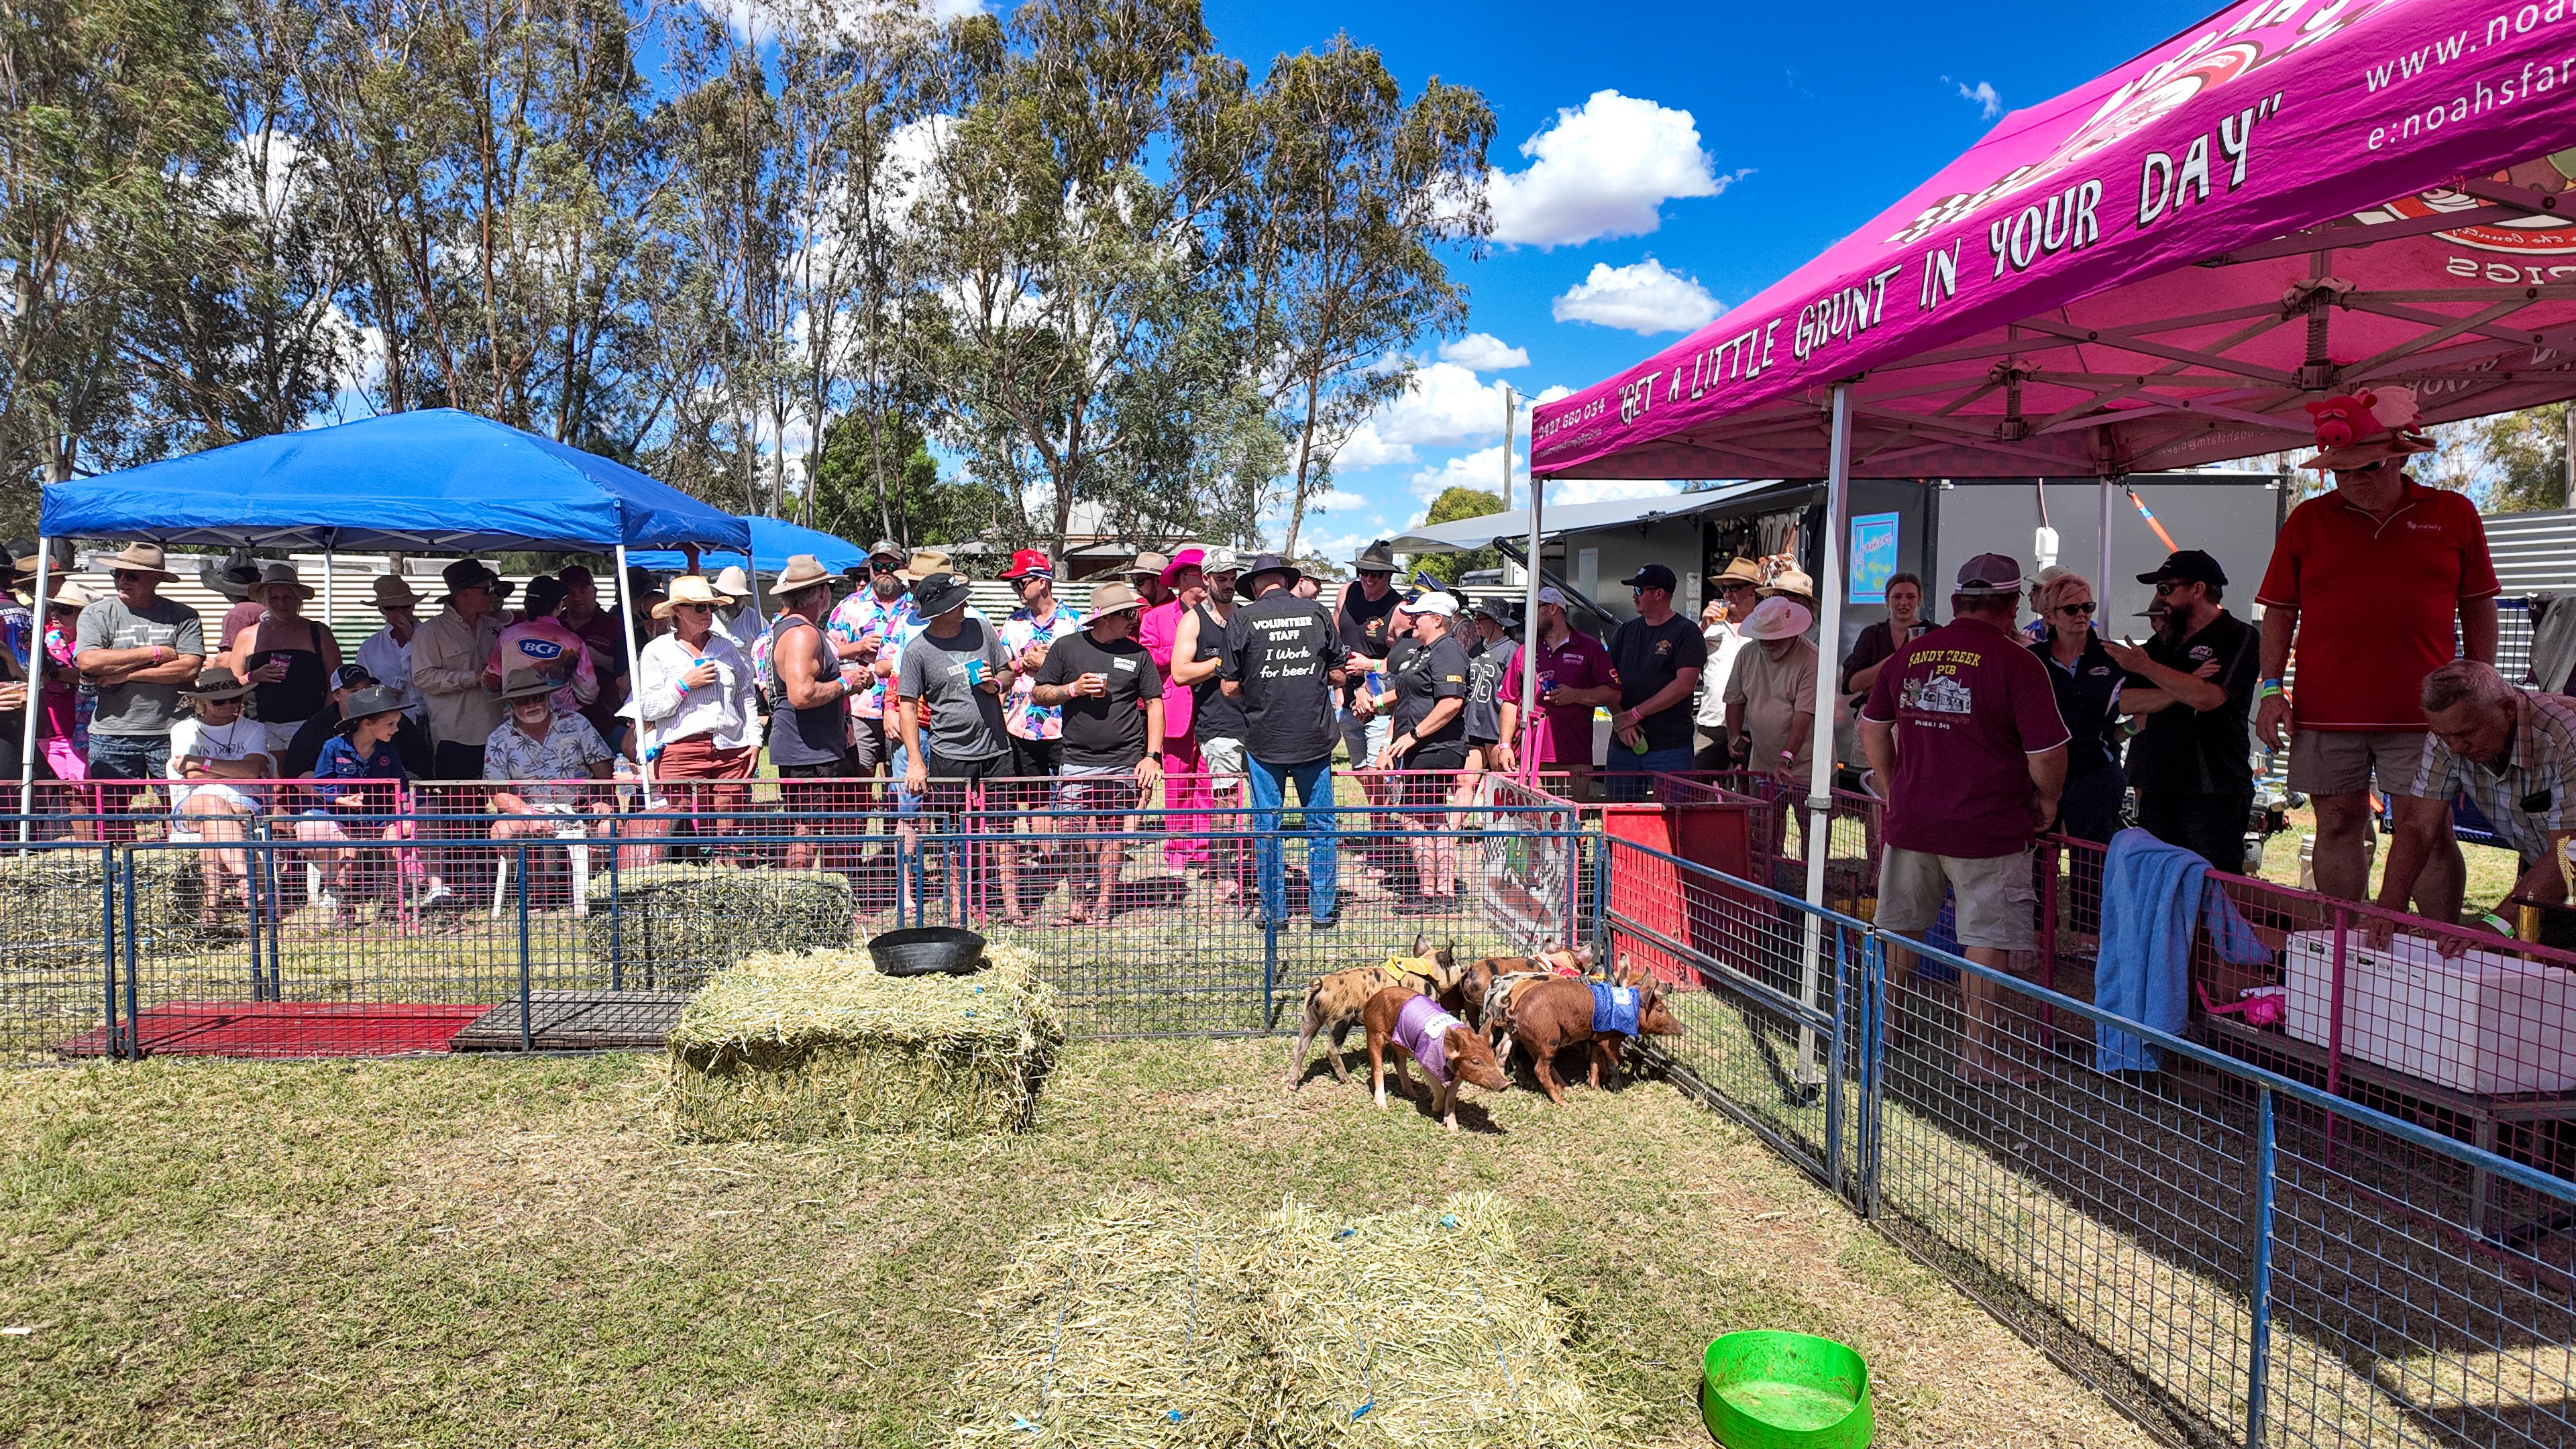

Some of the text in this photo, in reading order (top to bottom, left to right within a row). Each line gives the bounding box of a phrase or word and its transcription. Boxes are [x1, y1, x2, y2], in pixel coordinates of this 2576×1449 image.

[2366, 0, 2576, 93] www.noa
[2368, 57, 2576, 150] e:noahsfar
[1618, 90, 2284, 425] "GET A LITTLE GRUNT IN YOUR DAY"
[1538, 397, 1605, 440] 0427 660 034
[1252, 616, 1313, 631] VOLUNTEER
[1269, 629, 1300, 641] STAFF
[523, 642, 557, 655] BCF
[1265, 645, 1311, 661] I Work
[1908, 650, 1982, 669] SANDY CREEK
[1259, 662, 1316, 679] for beer!
[1935, 664, 1957, 676] PUB
